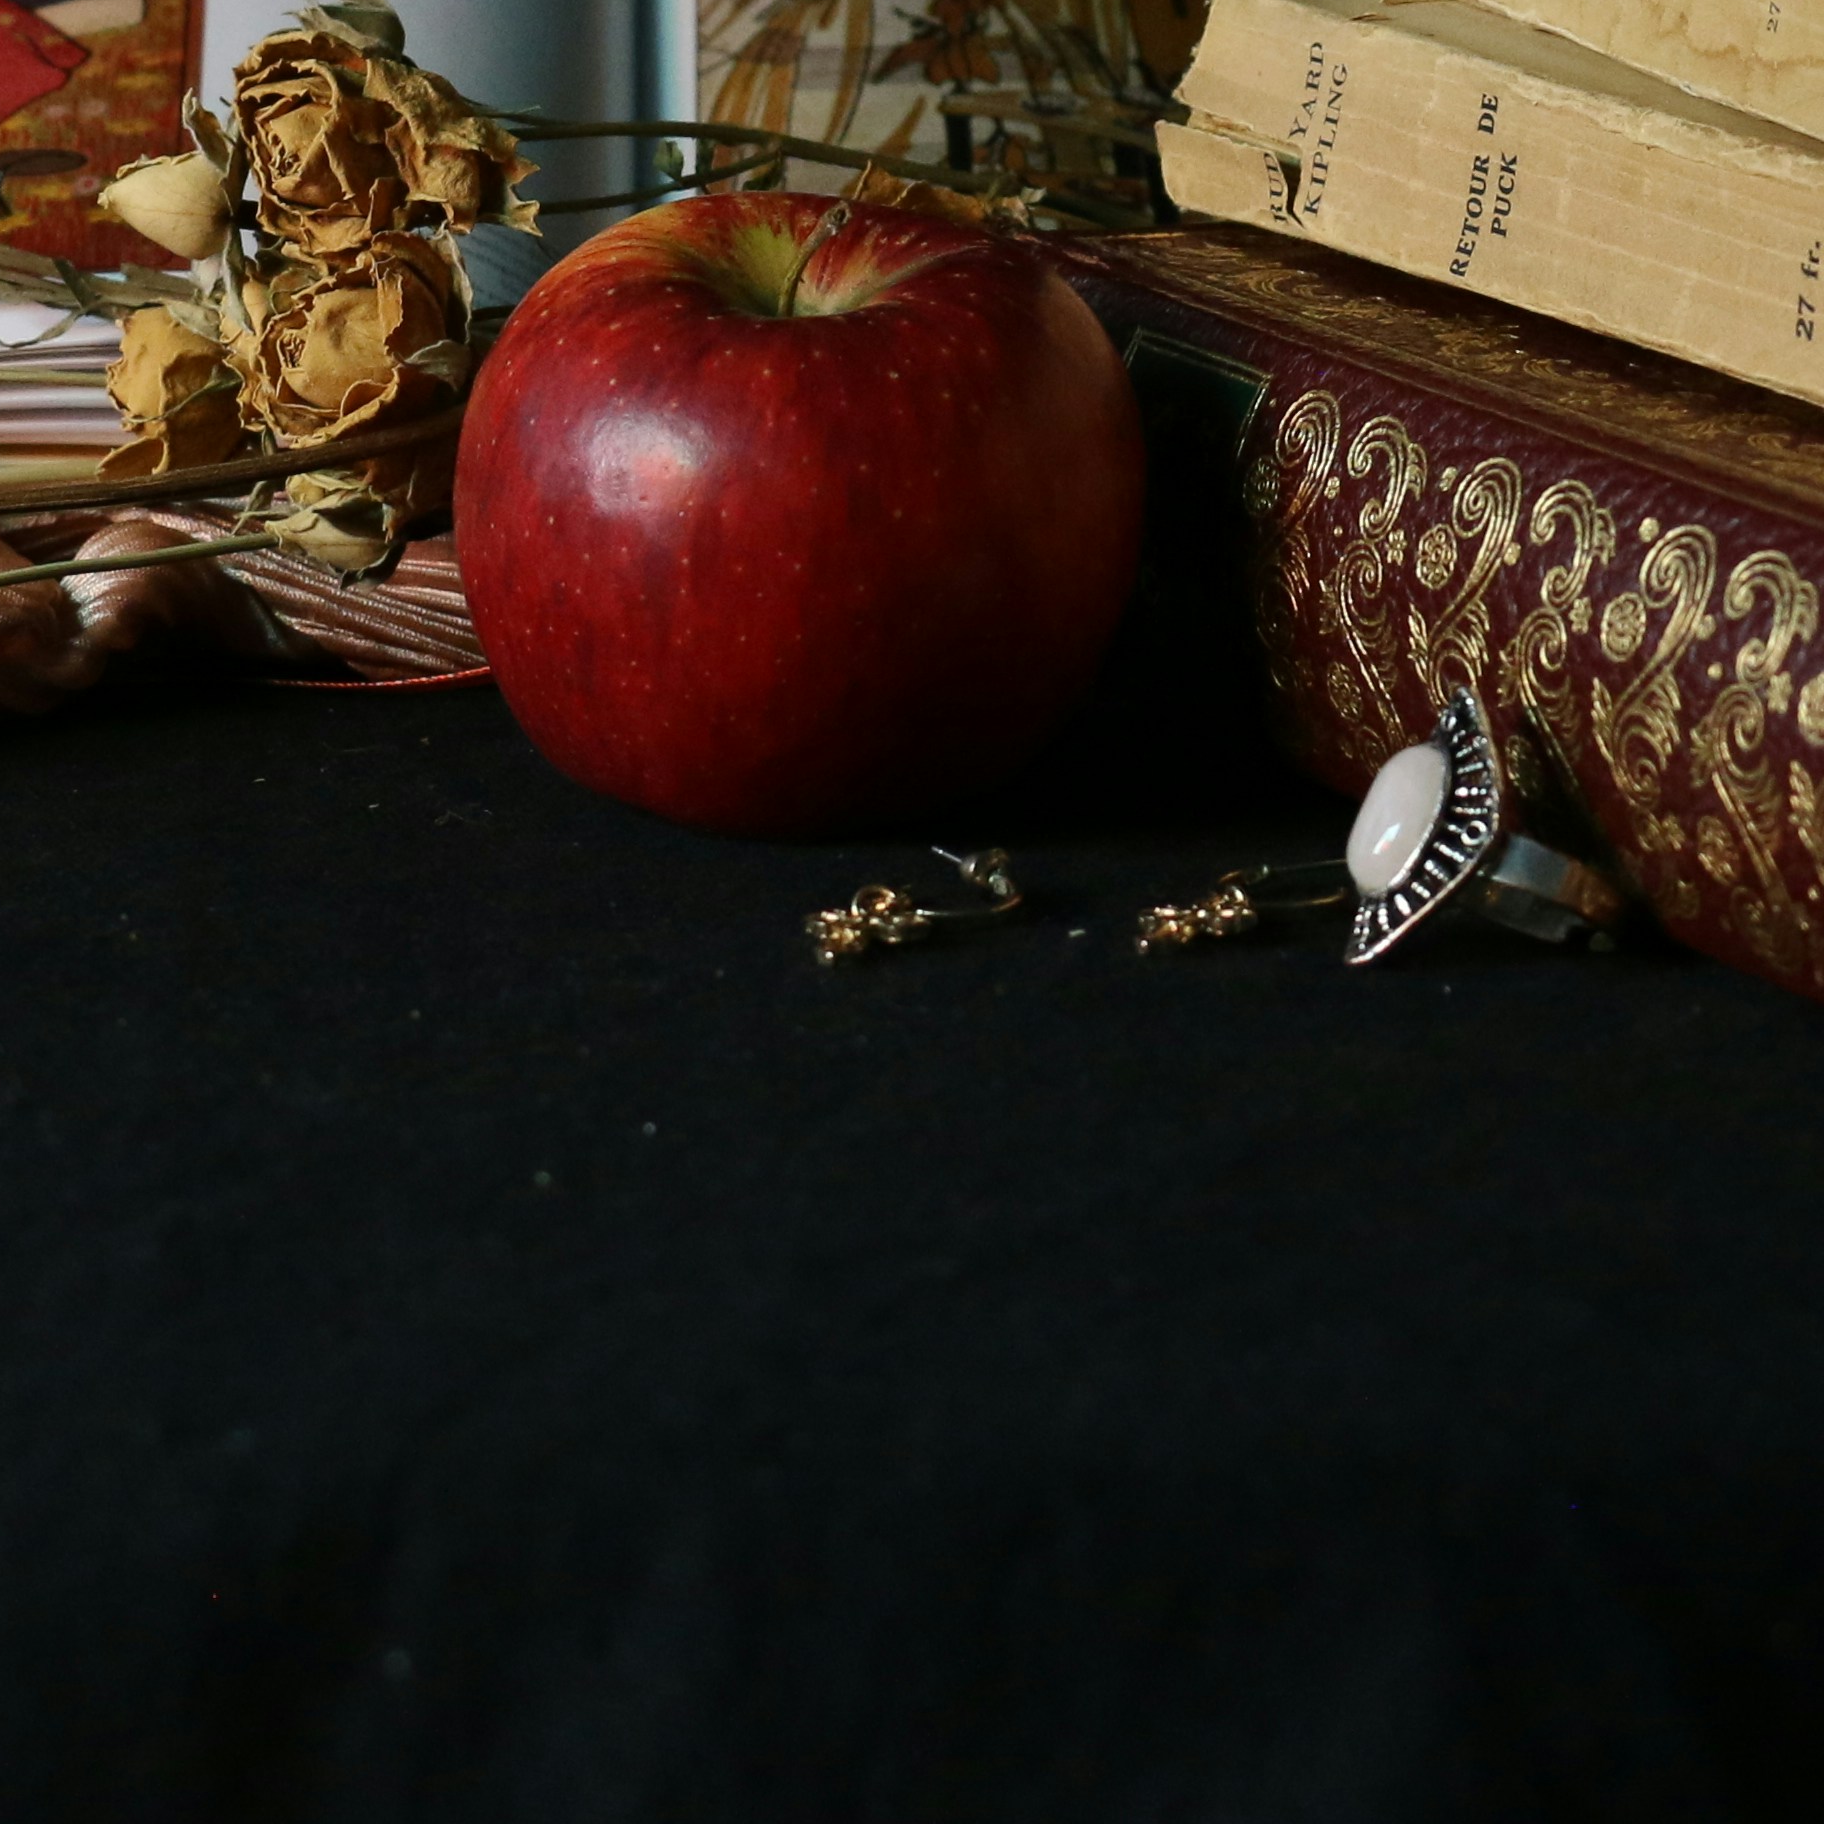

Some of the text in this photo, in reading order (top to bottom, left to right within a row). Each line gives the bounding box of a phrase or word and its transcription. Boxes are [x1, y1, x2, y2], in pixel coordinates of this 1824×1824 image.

[1766, 1, 1781, 34] 27
[1303, 63, 1349, 217] KIPLING
[1449, 93, 1499, 278] RETOUR DE
[1491, 151, 1518, 238] PUCK
[1796, 241, 1821, 342] 27 fr.
